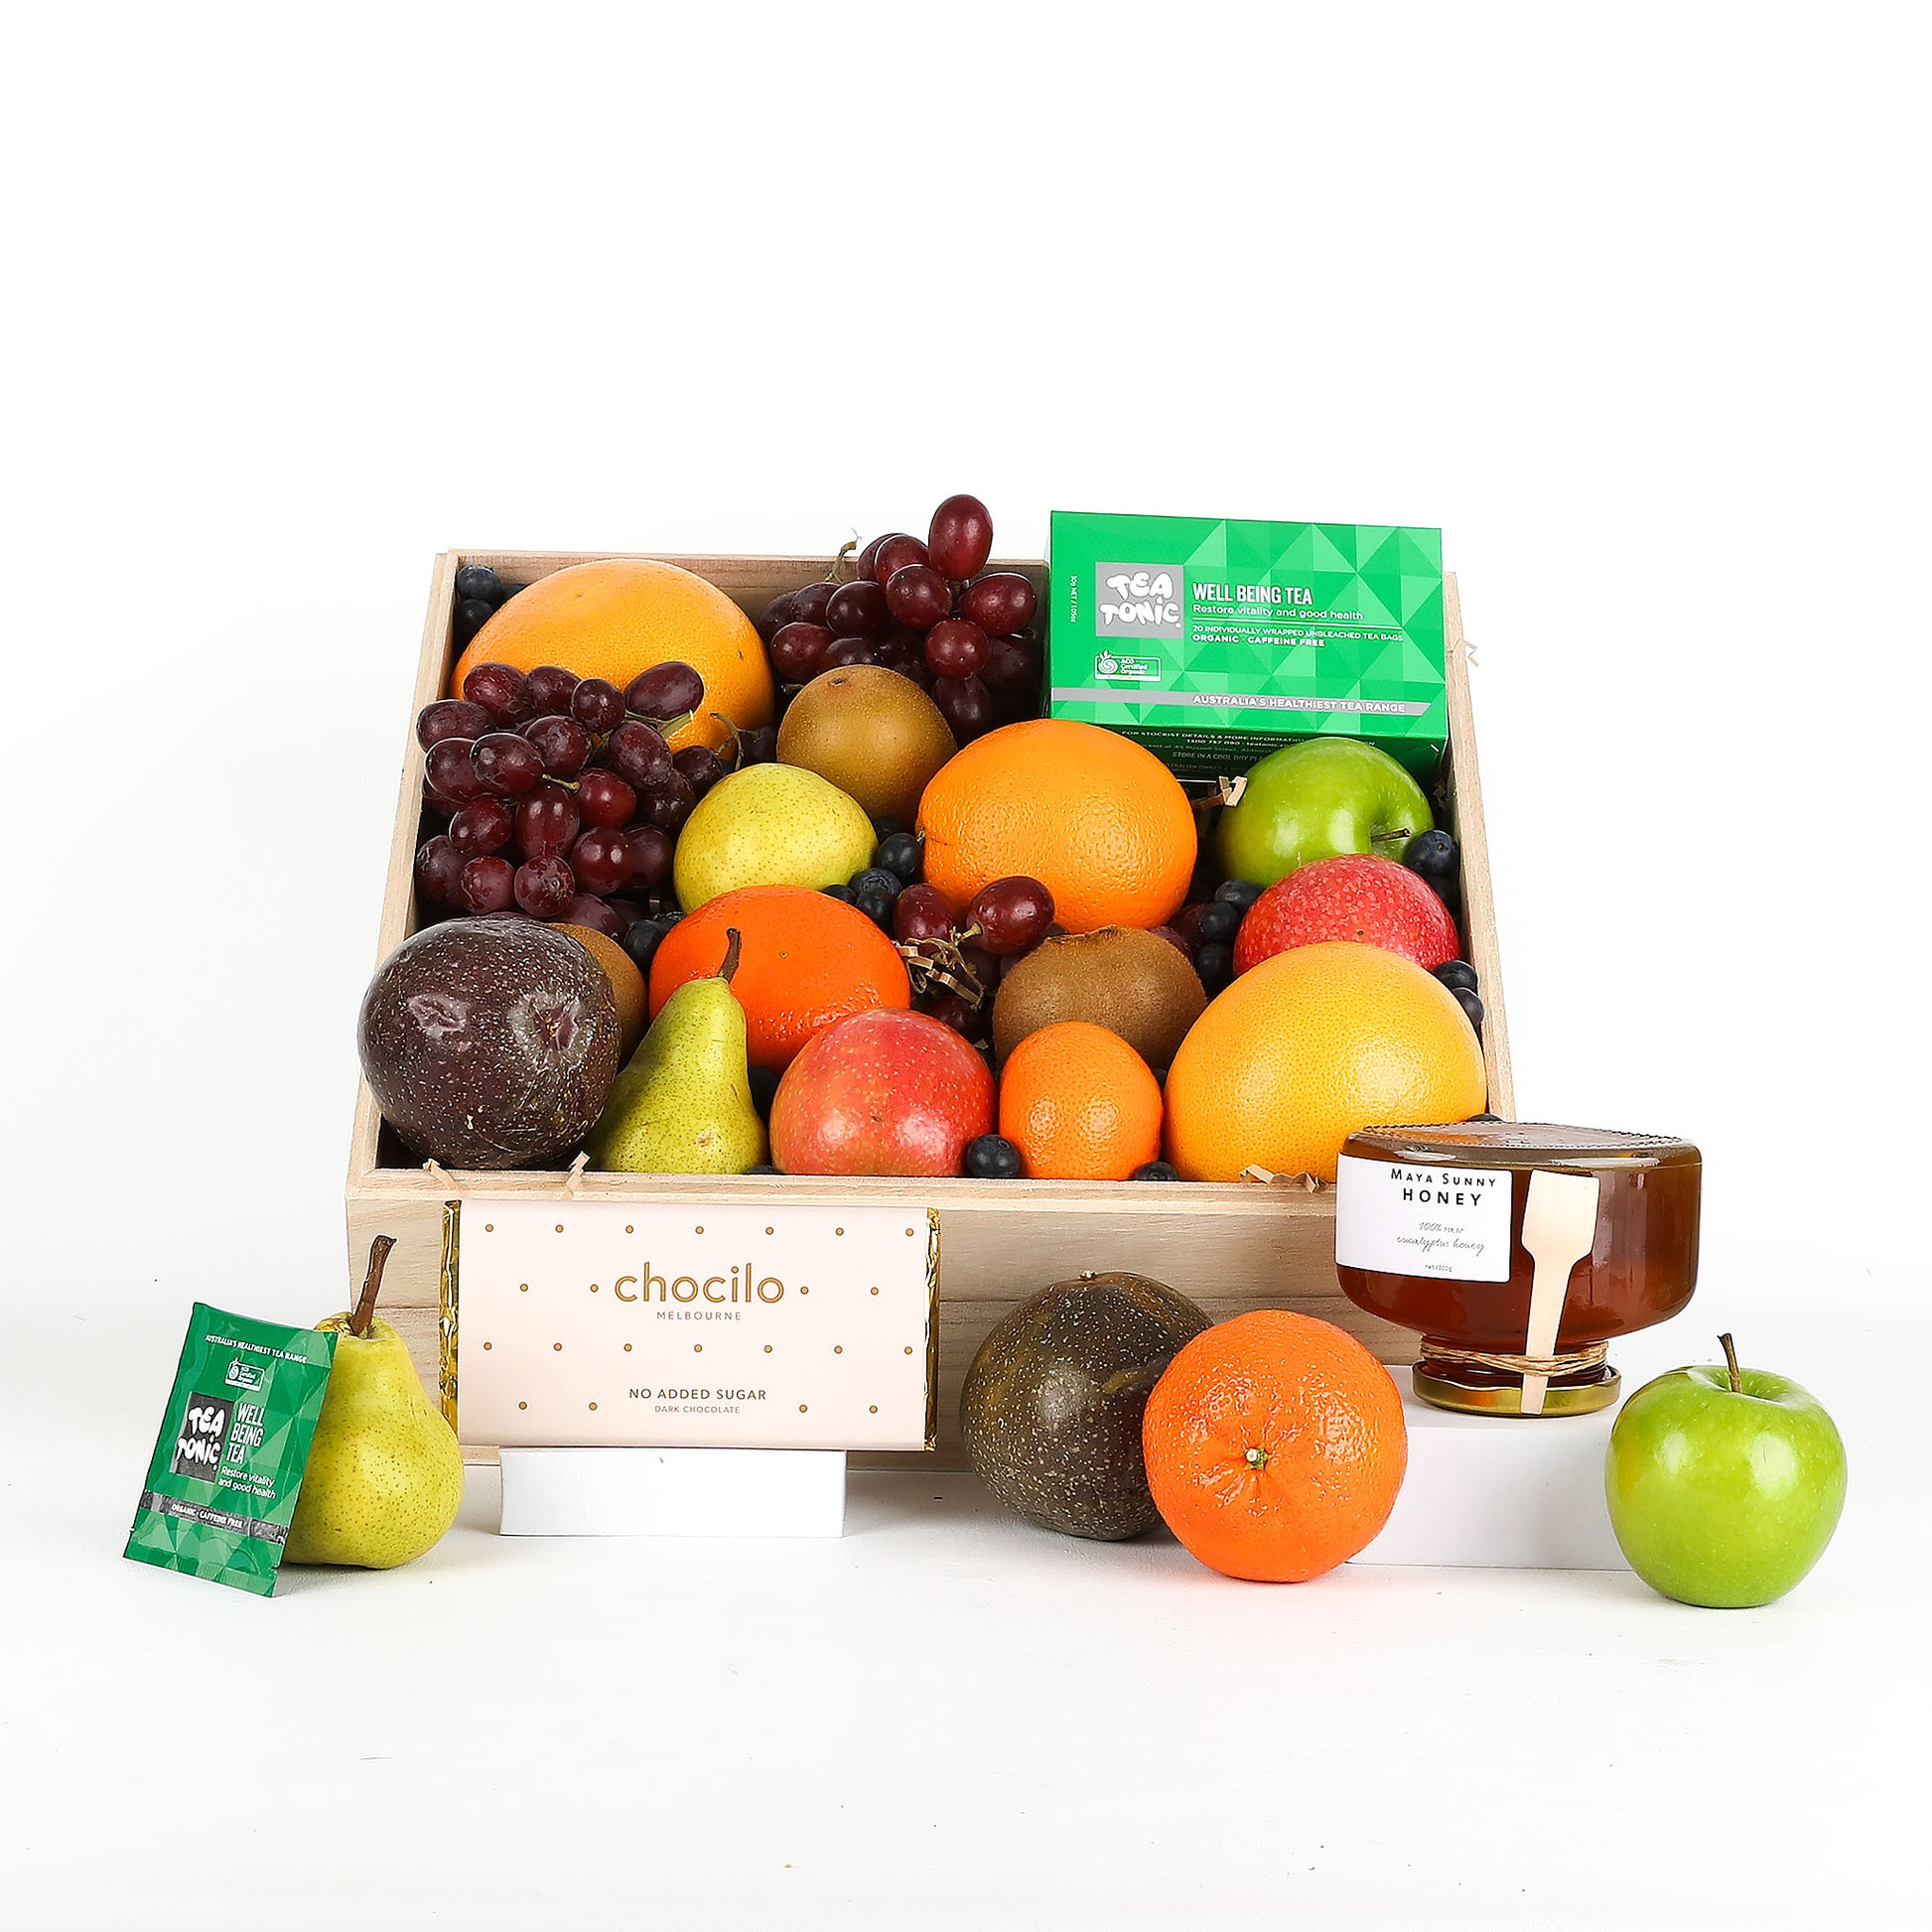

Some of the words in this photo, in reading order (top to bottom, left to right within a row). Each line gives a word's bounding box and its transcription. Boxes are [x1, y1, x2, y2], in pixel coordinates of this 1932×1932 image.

[1106, 571, 1173, 600] TEA
[1192, 583, 1233, 601] WELL
[1237, 585, 1281, 604] BEING
[1285, 587, 1312, 605] TEA
[1192, 604, 1235, 615] Restore
[1237, 606, 1273, 618] vitality
[1276, 608, 1297, 618] and
[1299, 610, 1327, 620] good
[1330, 610, 1364, 621] health
[1192, 634, 1239, 643] ORGANIC
[1247, 636, 1297, 645] CAFFEINE
[1205, 625, 1261, 634] INDIVIDUALLY
[1263, 627, 1305, 637] WRAPPED
[1306, 629, 1361, 639] UNBLEACHED
[1362, 631, 1379, 640] TEA
[1192, 695, 1267, 707] AUSTRALIA'S
[1269, 698, 1337, 710] HEALTHIEST
[1340, 701, 1362, 711] TEA
[1365, 702, 1406, 713] RANGE
[1403, 1187, 1481, 1206] HONEY
[1418, 1221, 1443, 1232] 100%
[1396, 1236, 1449, 1253] eucalyptus
[1452, 1238, 1485, 1257] honey
[615, 1261, 784, 1304] chocilo
[656, 1311, 742, 1320] MELBOURNE
[205, 1334, 238, 1347] AUSTRALIA'S
[238, 1341, 271, 1354] HEALTHIEST
[272, 1349, 284, 1358] TEA
[284, 1352, 308, 1364] RANGE
[629, 1388, 651, 1399] NO
[657, 1389, 711, 1400] ADDED
[717, 1390, 766, 1400] SUGAR
[189, 1406, 225, 1438] TEA
[237, 1402, 264, 1427] WELL
[230, 1422, 264, 1448] BEING
[226, 1442, 246, 1464] TEA
[220, 1465, 248, 1481] Restore
[248, 1471, 275, 1488] vitality
[218, 1477, 231, 1487] and
[232, 1481, 252, 1493] good
[252, 1485, 276, 1499] health
[226, 1517, 242, 1529] FREE
